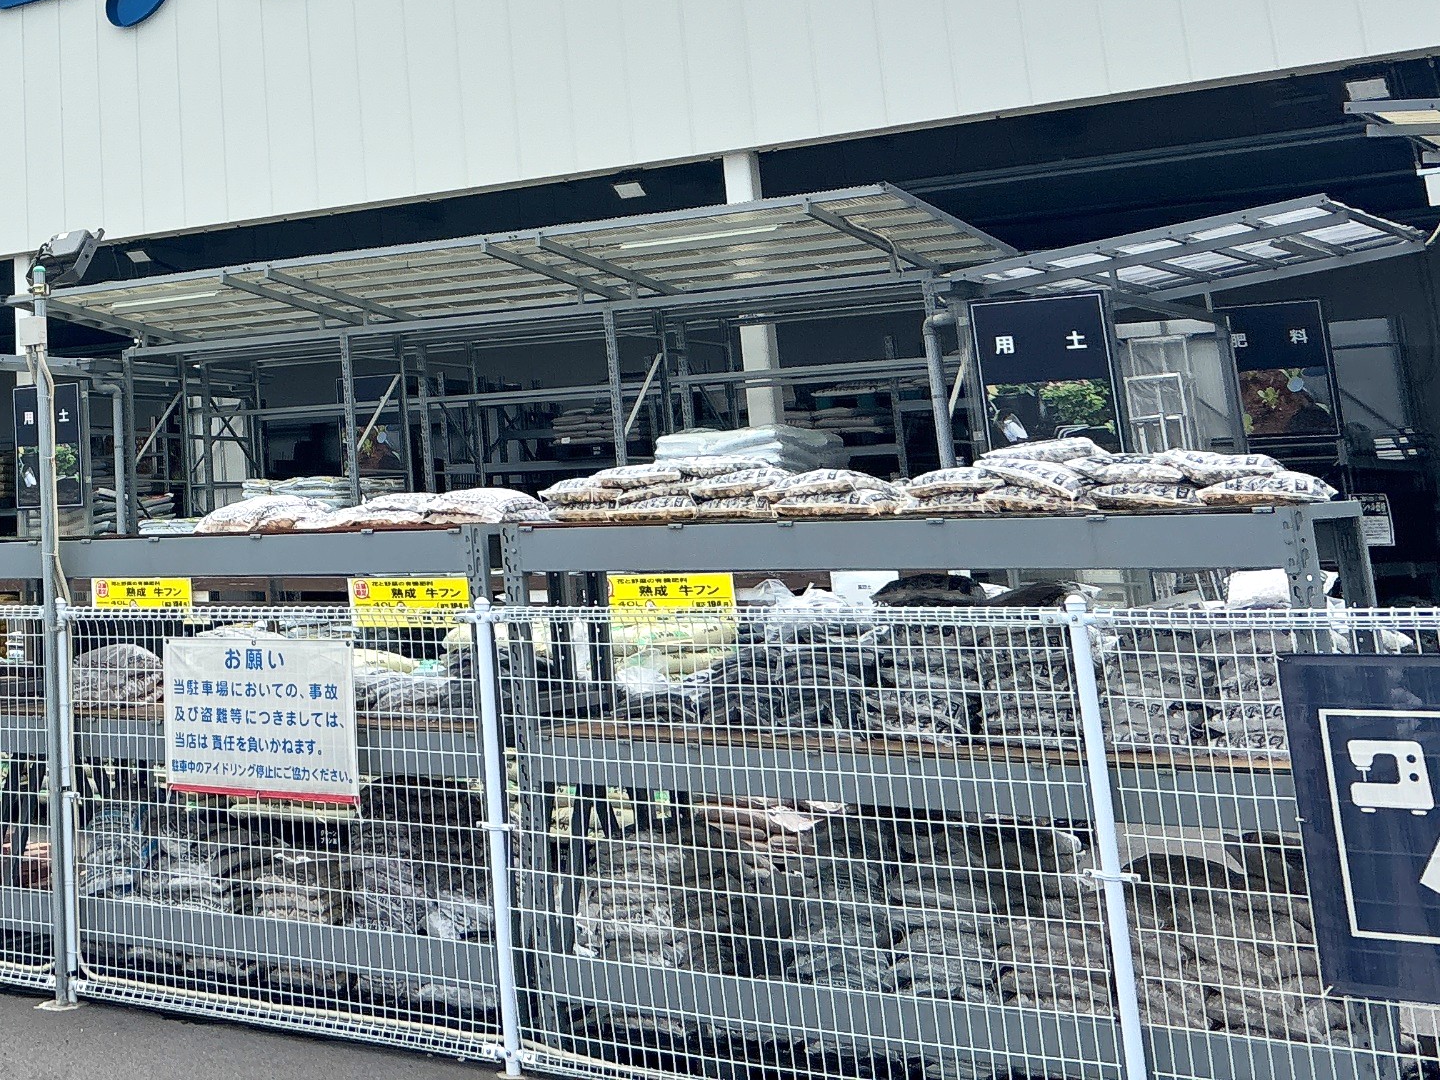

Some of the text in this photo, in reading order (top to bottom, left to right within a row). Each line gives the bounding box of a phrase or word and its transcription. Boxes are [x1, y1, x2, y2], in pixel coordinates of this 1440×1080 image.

[994, 329, 1088, 356] 用土
[126, 587, 182, 597] 熟成 牛フン
[391, 587, 461, 598] 熟成 牛フン
[639, 585, 720, 596] 熟成 牛フン
[224, 648, 285, 670] お願い
[173, 678, 338, 701] 当駐車場においての、事故
[175, 706, 345, 729] 及び盗難等につきましては、
[175, 732, 322, 756] 当店は責任を負いかねます。
[171, 759, 353, 784] 駐車中のアイドリング停止にご協力ください。
